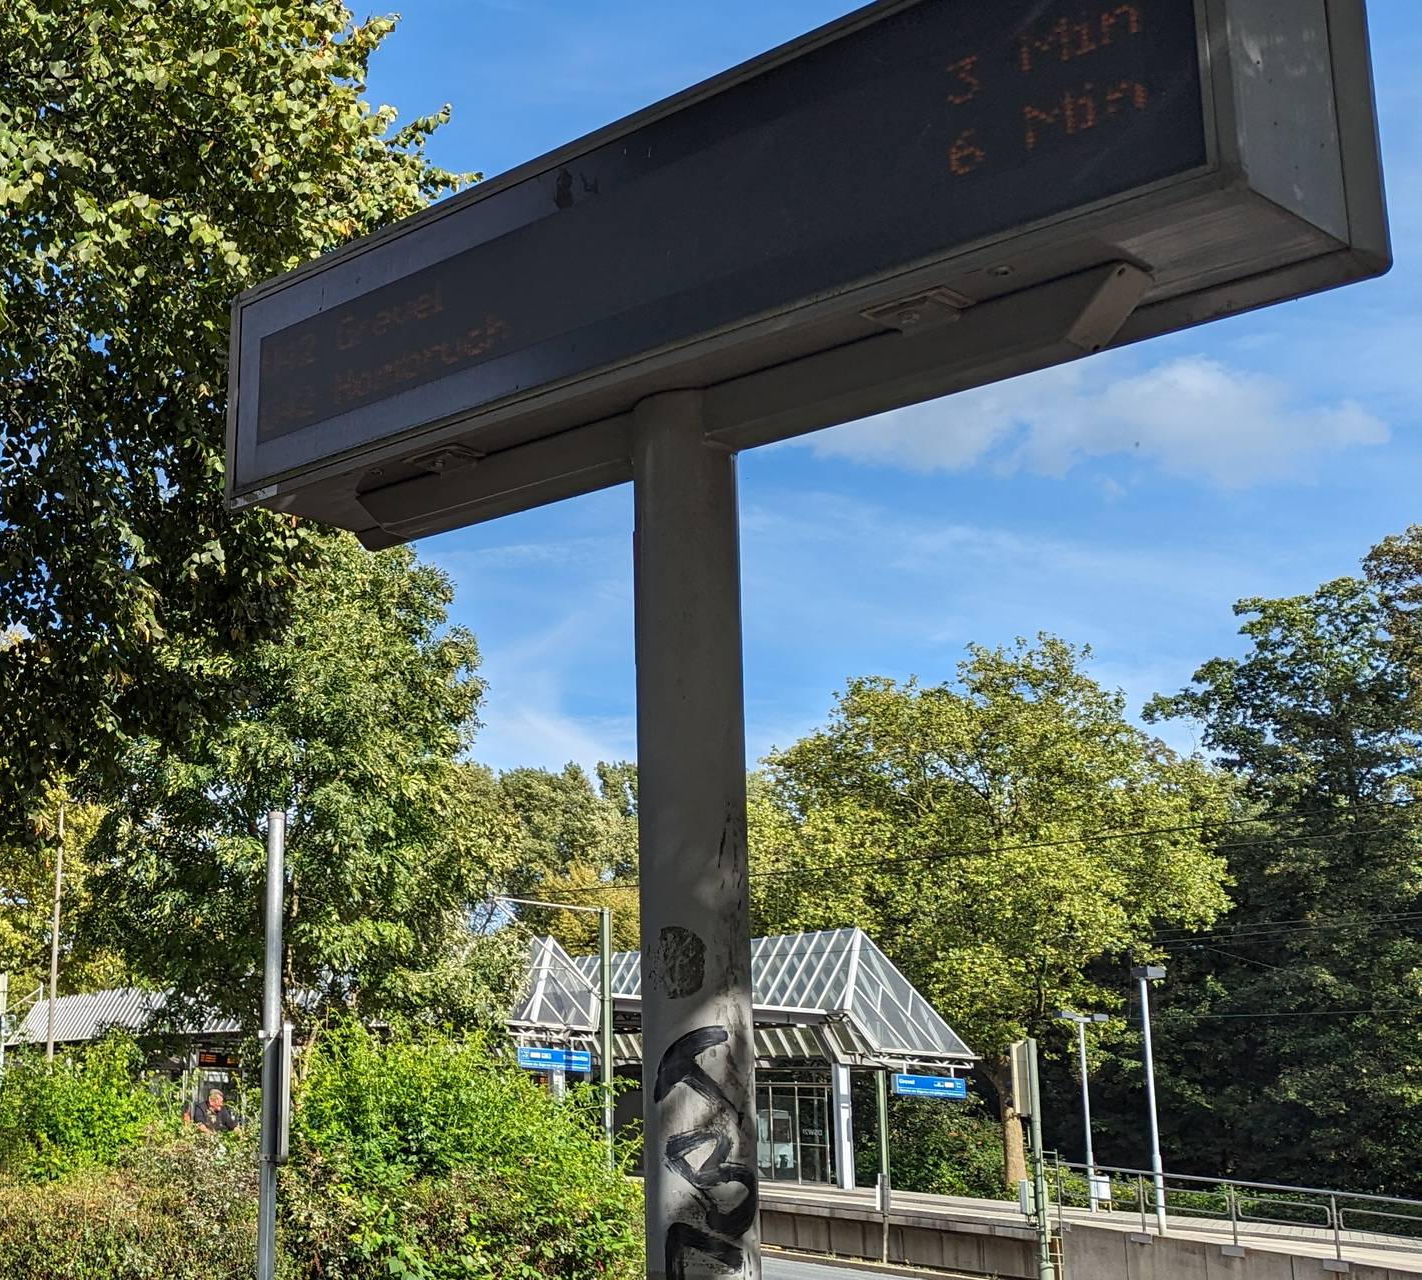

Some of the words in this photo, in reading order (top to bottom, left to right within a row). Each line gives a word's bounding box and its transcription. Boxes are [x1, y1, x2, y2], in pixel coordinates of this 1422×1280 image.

[946, 54, 980, 104] 3
[1020, 4, 1139, 72] Min
[948, 129, 986, 175] 6
[1024, 81, 1148, 149] Min
